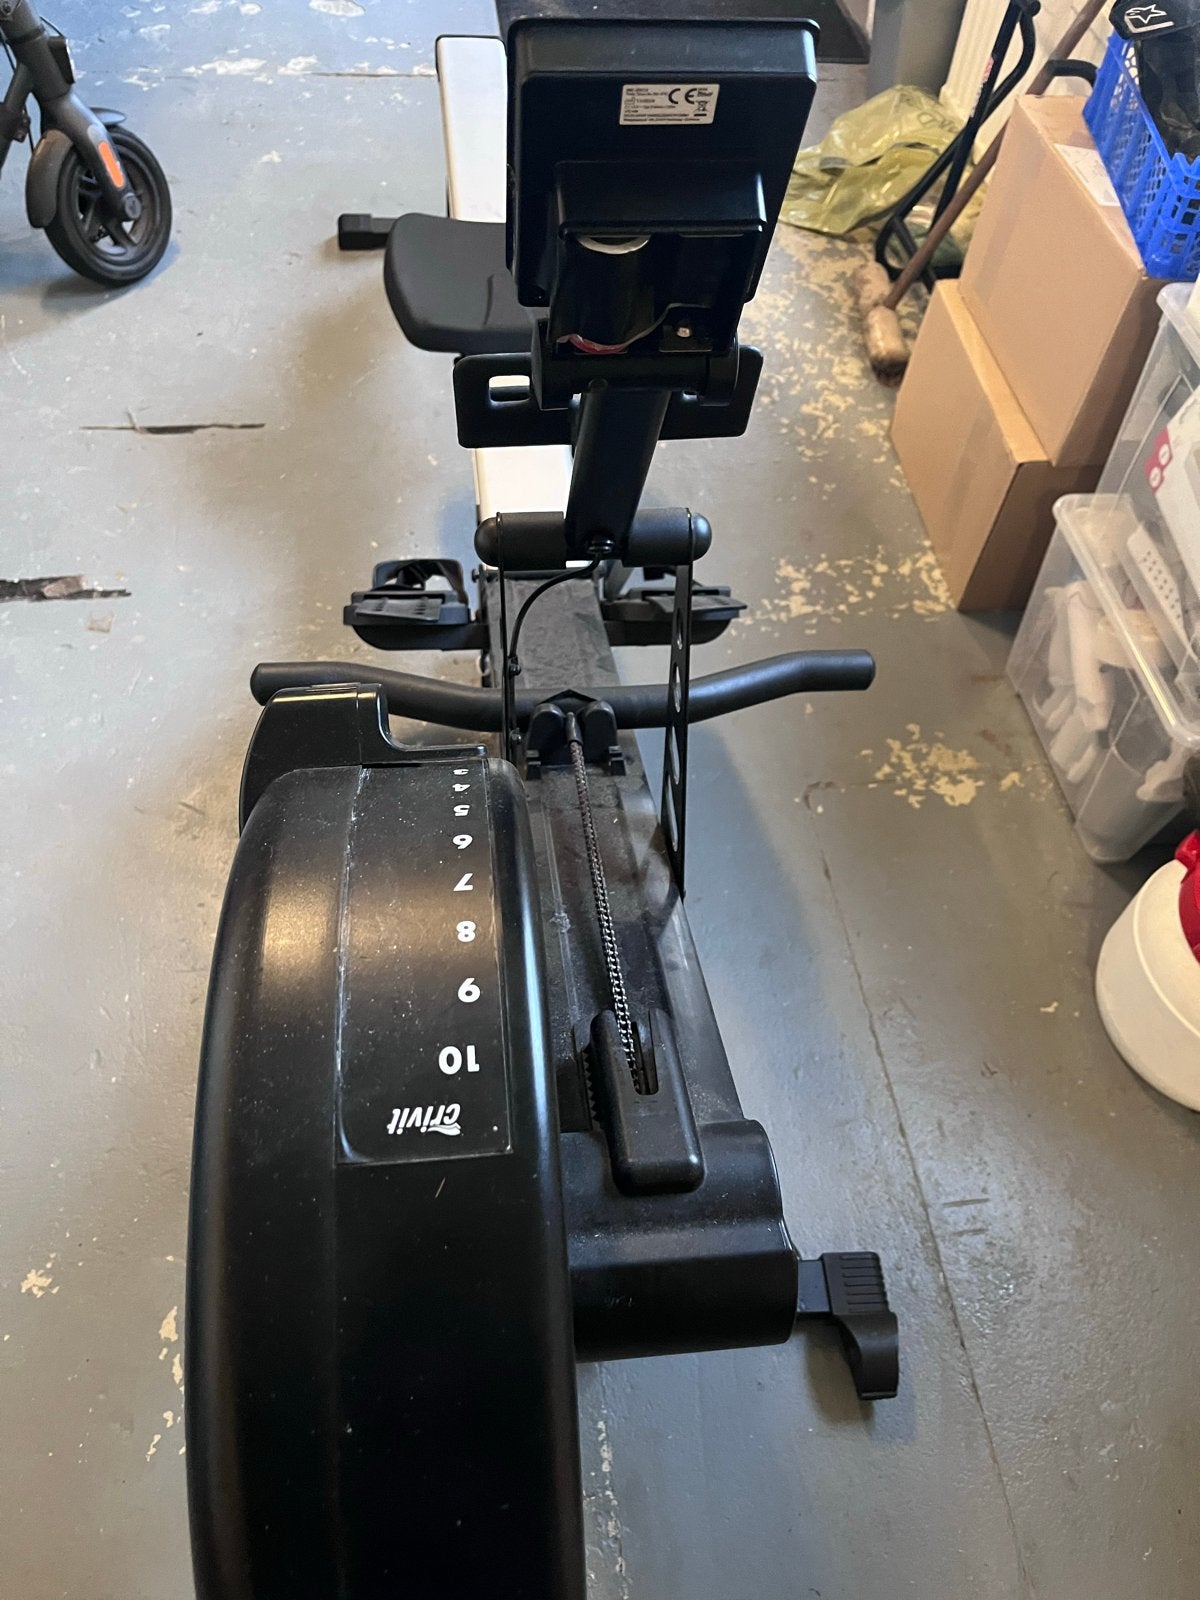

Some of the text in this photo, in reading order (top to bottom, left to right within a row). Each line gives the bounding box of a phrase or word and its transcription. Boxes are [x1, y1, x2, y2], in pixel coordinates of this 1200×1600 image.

[452, 783, 471, 792] 4
[453, 804, 470, 816] 5
[452, 834, 473, 850] 6
[453, 872, 474, 892] 7
[456, 920, 477, 943] 8
[457, 977, 481, 1003] 9
[438, 1045, 480, 1075] 10
[387, 1104, 461, 1136] crivit
